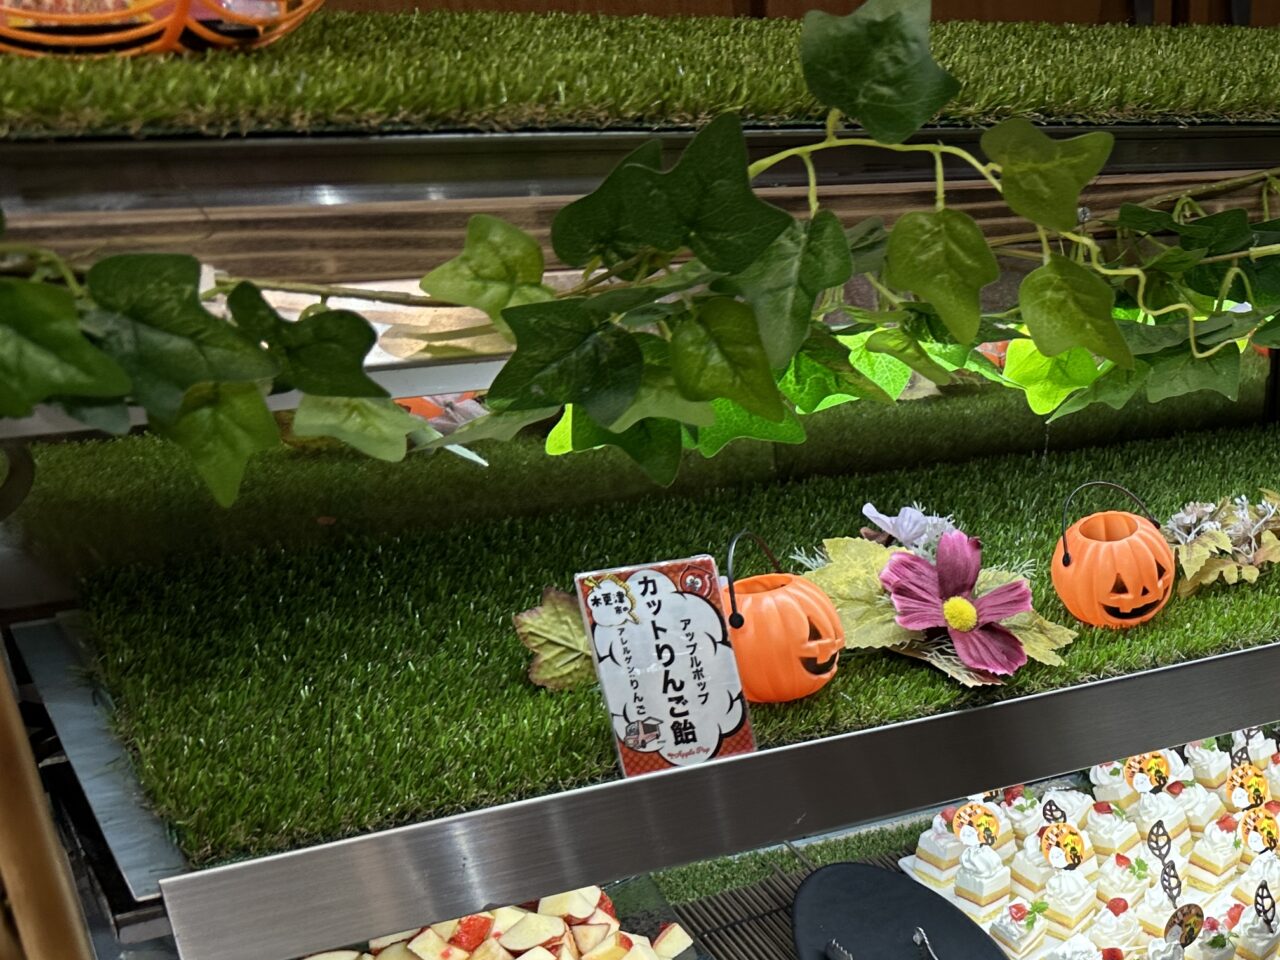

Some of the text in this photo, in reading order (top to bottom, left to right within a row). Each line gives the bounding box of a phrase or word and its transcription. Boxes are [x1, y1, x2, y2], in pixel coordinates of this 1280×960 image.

[591, 591, 626, 607] 木更津
[638, 576, 698, 746] カットりんご飴
[680, 618, 710, 705] アップルポップ
